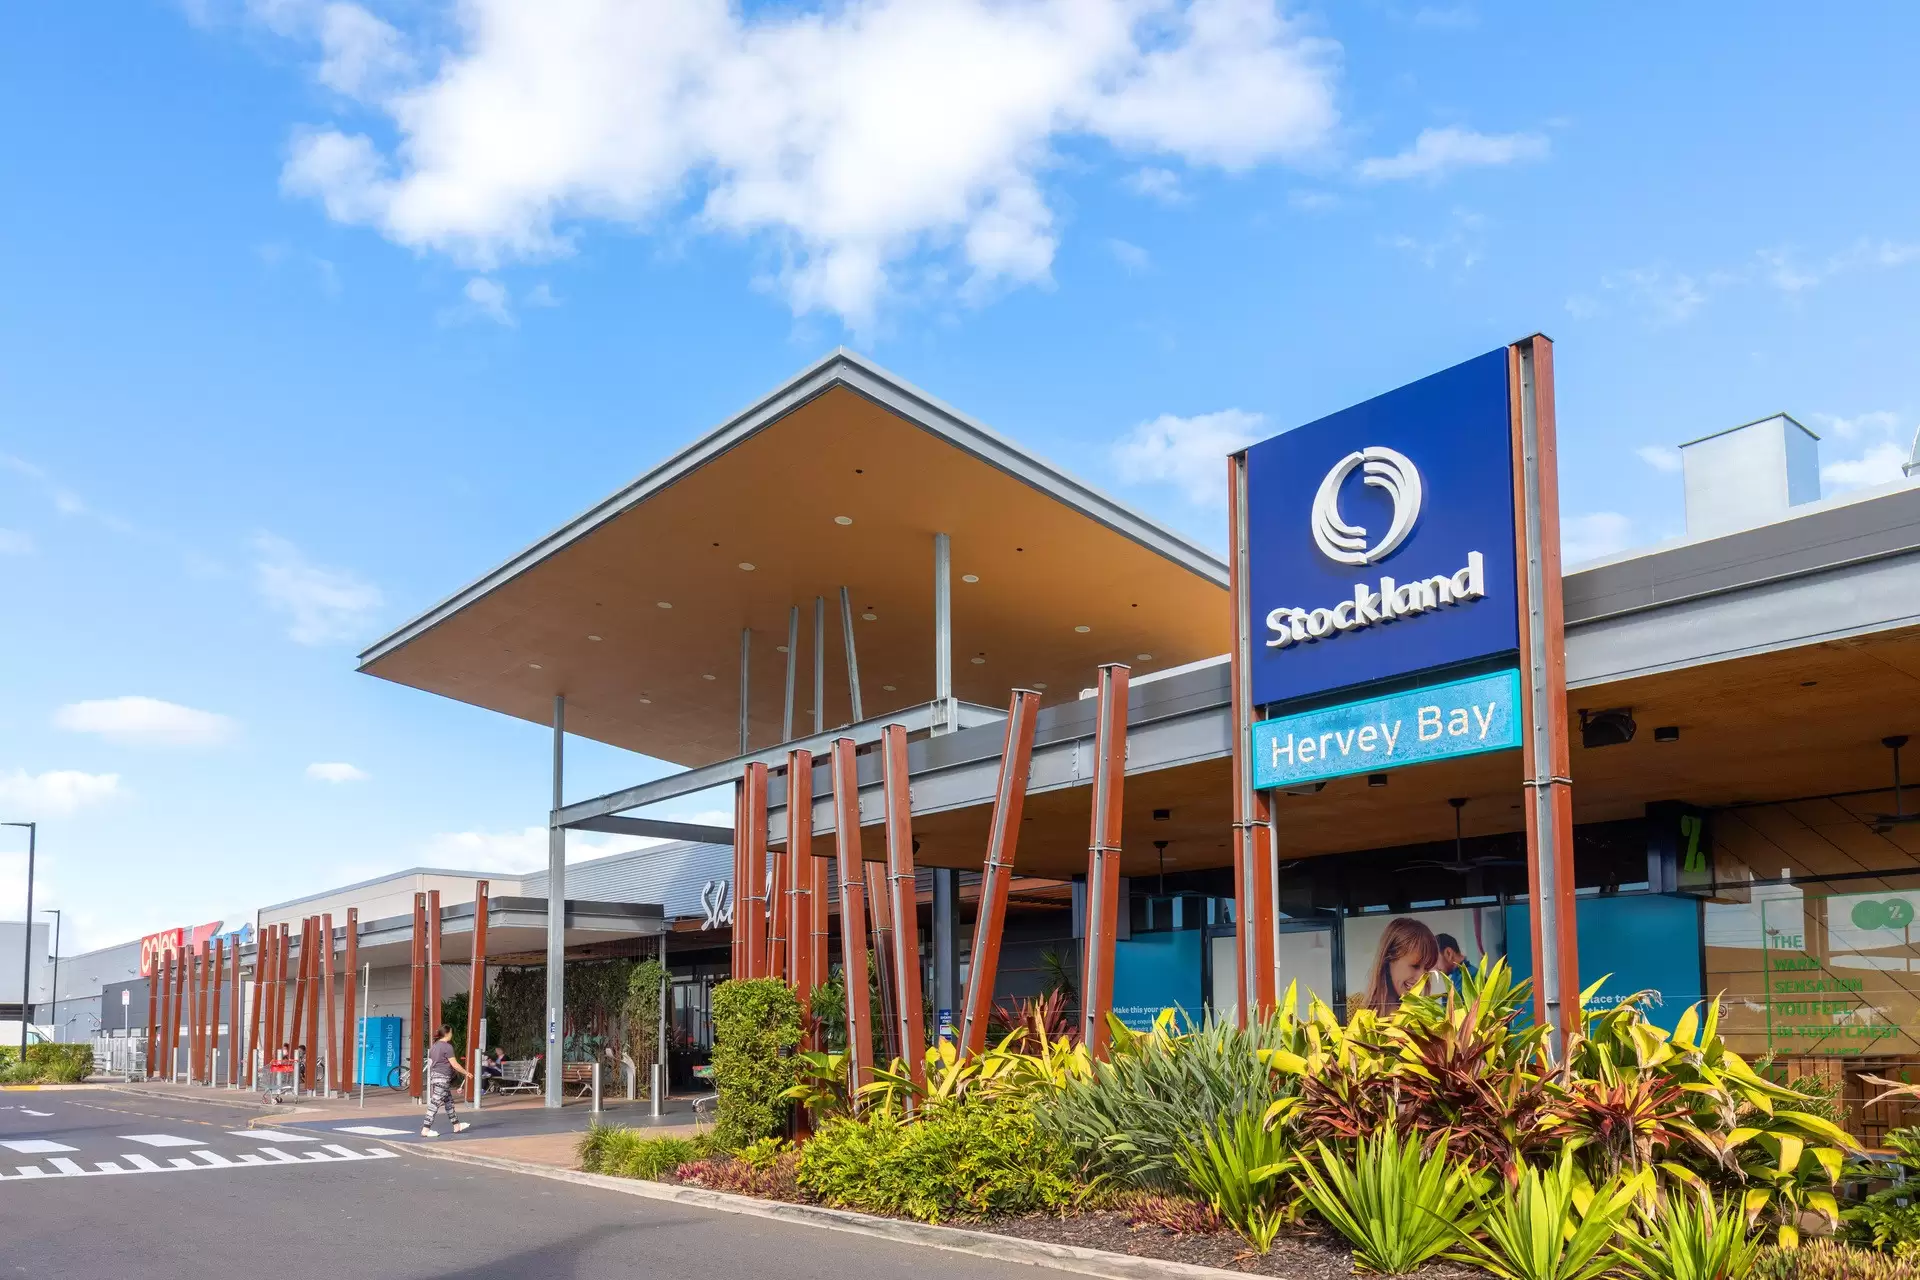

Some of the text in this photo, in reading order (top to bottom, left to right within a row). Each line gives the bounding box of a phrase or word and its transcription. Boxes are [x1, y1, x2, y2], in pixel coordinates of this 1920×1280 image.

[1266, 550, 1485, 647] Stockland
[1271, 702, 1497, 768] Hervey Bay
[1774, 935, 1802, 948] THE
[1773, 957, 1820, 970] WARM
[1775, 977, 1863, 993] SENSATION
[1113, 1006, 1130, 1014] Make
[1130, 1006, 1143, 1014] this
[1143, 1007, 1159, 1015] your
[1776, 1001, 1852, 1016] YOU FEEL
[1796, 1024, 1842, 1039] YOUR
[1845, 1024, 1900, 1039] CHEST
